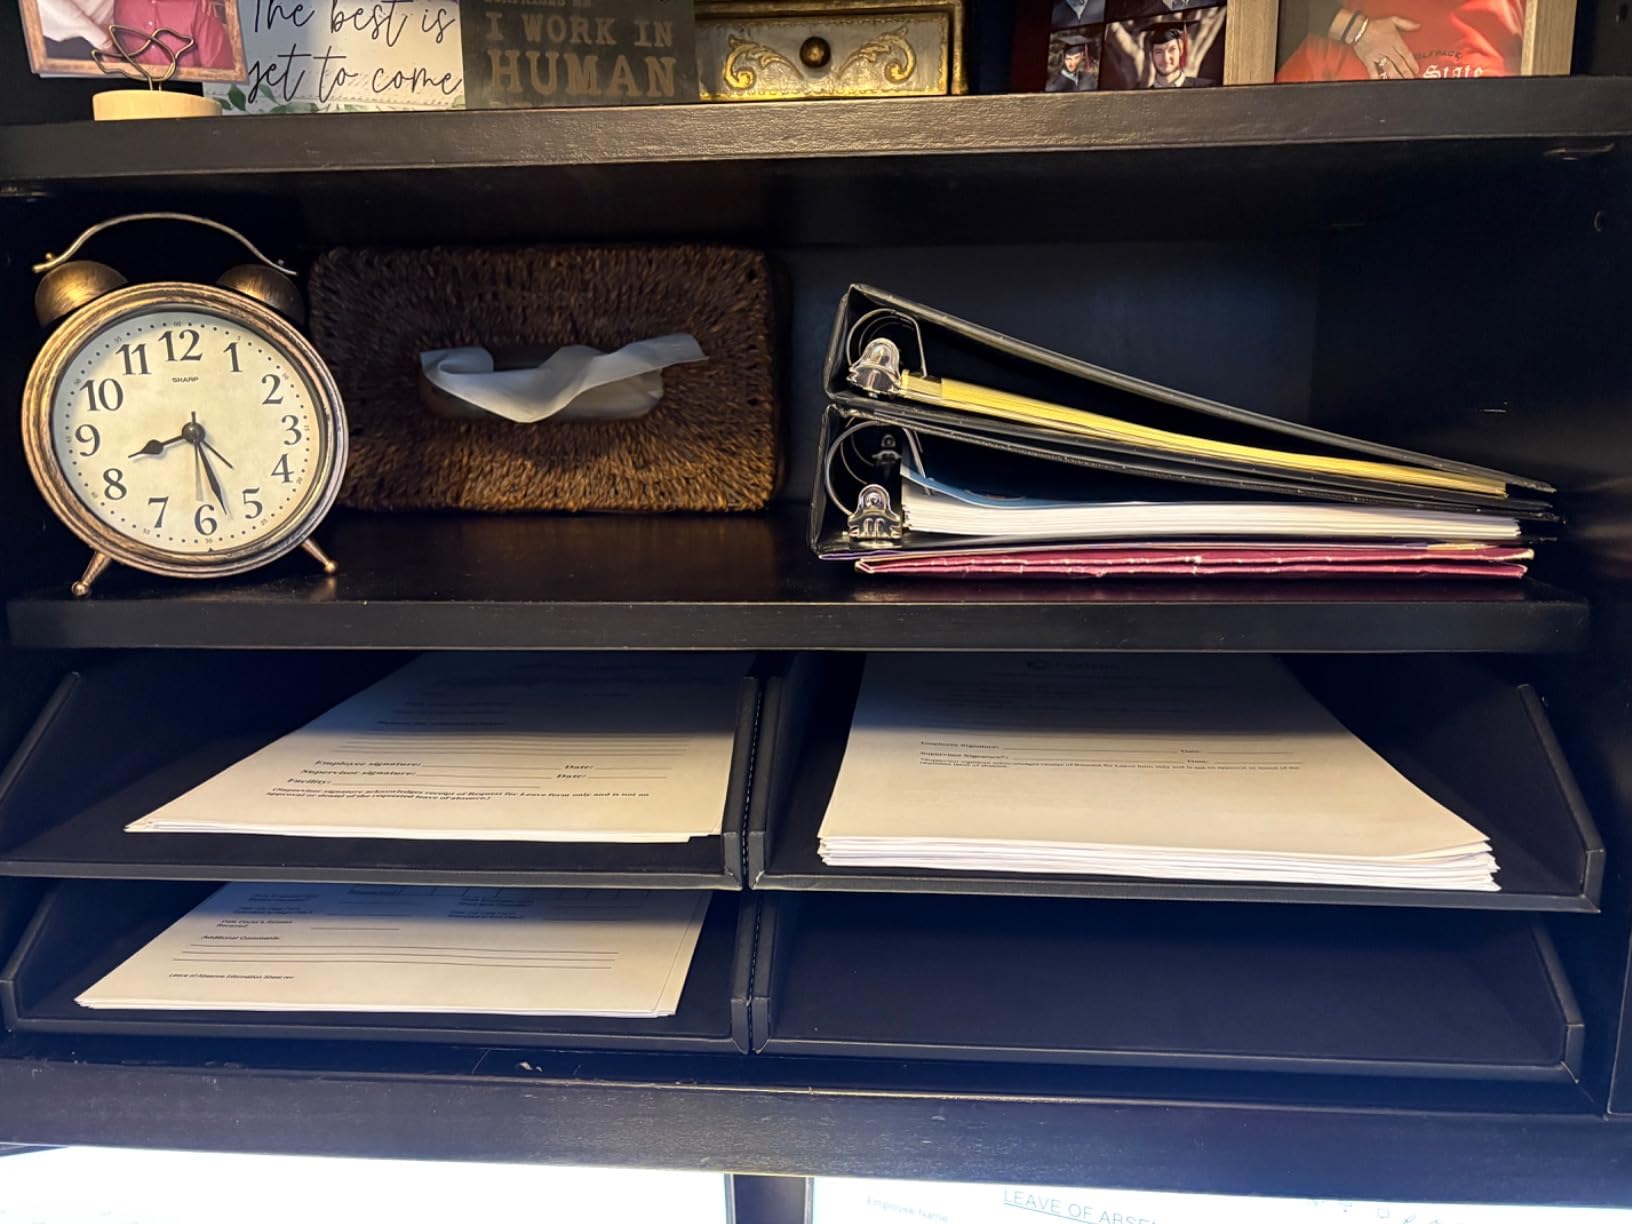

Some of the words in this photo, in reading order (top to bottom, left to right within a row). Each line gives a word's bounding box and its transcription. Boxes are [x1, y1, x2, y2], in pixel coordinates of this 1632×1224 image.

[331, 0, 408, 47] best
[421, 8, 456, 44] is
[485, 11, 504, 41] I
[521, 13, 617, 46] WORK
[633, 19, 674, 48] IN
[248, 43, 312, 105] yet
[312, 46, 358, 103] to
[372, 67, 463, 96] come
[487, 48, 677, 98] HUMAN
[115, 343, 152, 376] 11
[158, 329, 203, 362] 12
[223, 342, 243, 373] 1
[79, 378, 124, 412] 10
[261, 374, 284, 405] 2
[75, 424, 100, 457] 9
[281, 414, 302, 446] 3
[103, 468, 128, 500] 8
[271, 453, 295, 484] 4
[148, 496, 169, 529] 7
[242, 487, 263, 519] 5
[194, 504, 217, 536] 6
[1002, 1188, 1063, 1214] LEAVE
[1067, 1203, 1093, 1218] OF
